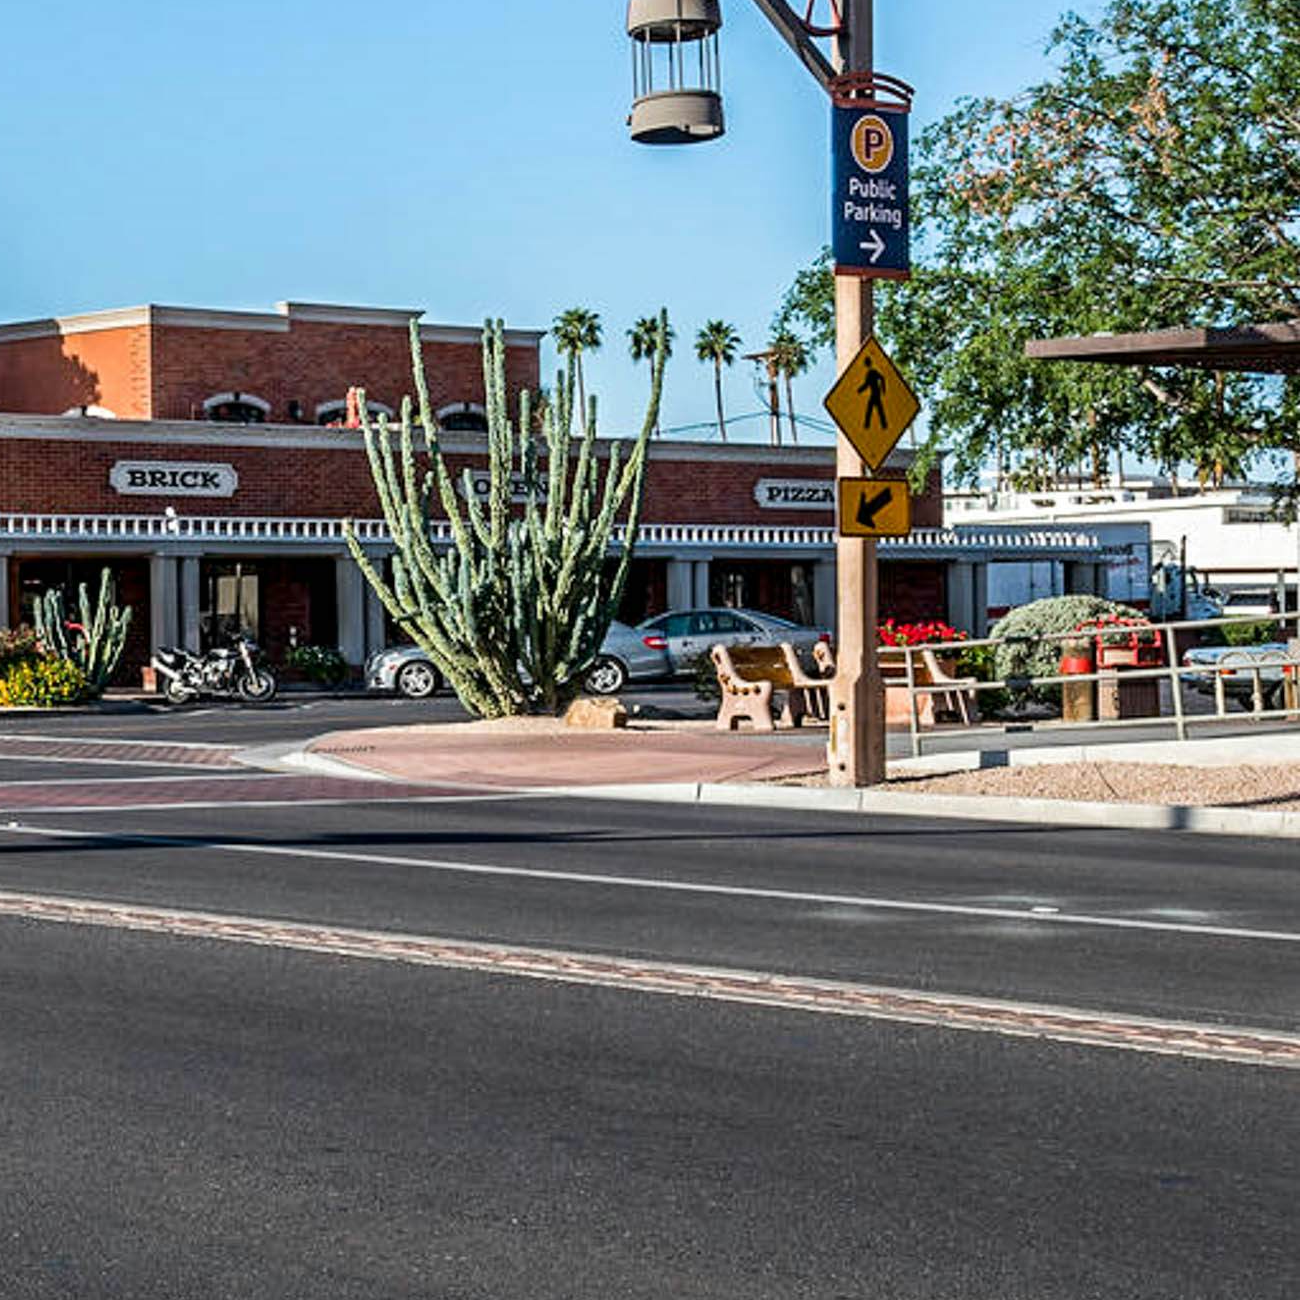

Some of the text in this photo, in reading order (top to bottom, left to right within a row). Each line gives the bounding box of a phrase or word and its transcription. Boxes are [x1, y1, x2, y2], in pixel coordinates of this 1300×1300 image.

[865, 128, 884, 160] P
[849, 178, 897, 200] Public
[844, 202, 903, 230] Parking
[127, 470, 220, 488] BRICK
[473, 479, 549, 495] OEN
[766, 486, 835, 502] PIZZA
